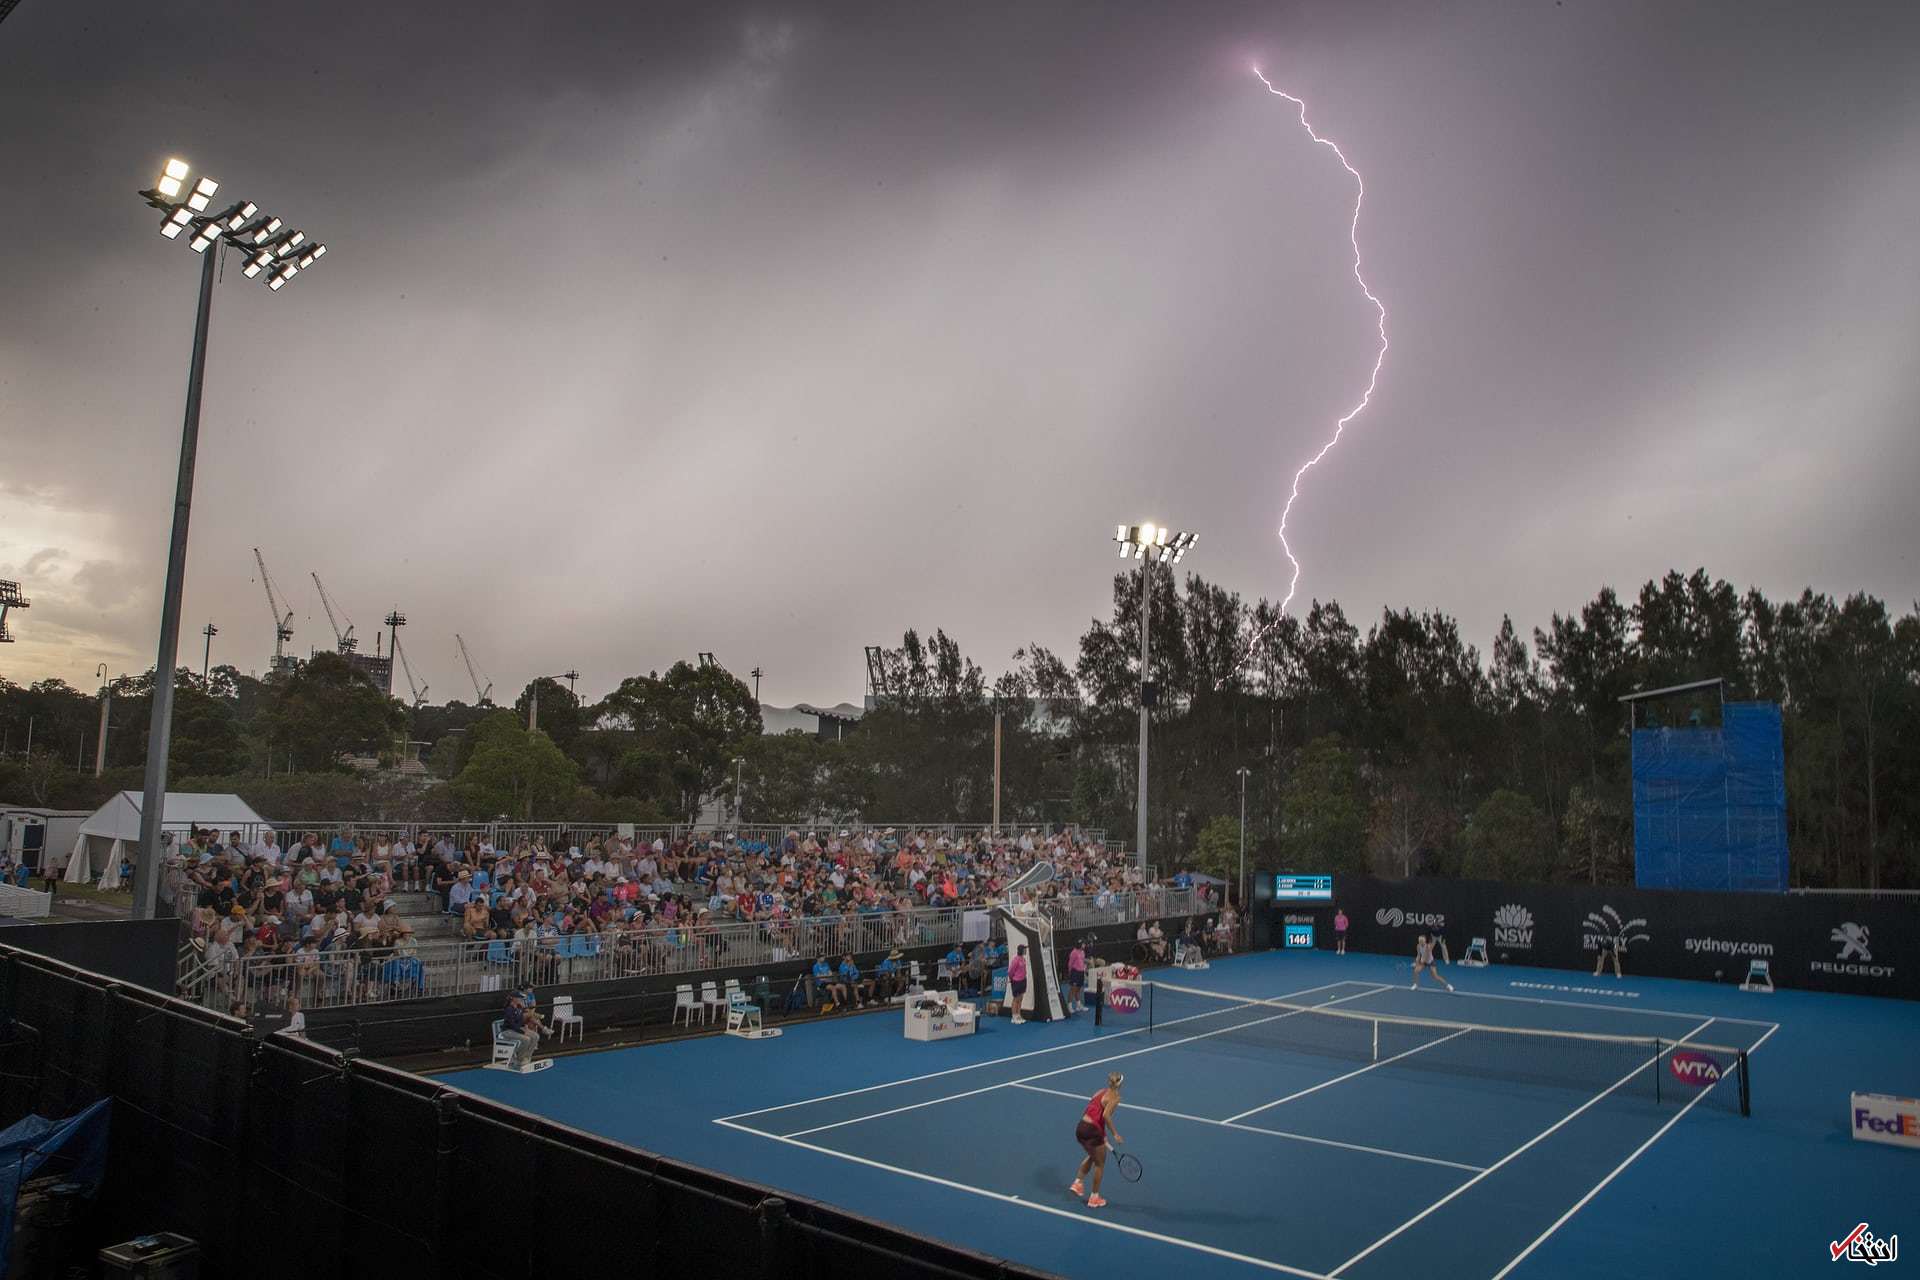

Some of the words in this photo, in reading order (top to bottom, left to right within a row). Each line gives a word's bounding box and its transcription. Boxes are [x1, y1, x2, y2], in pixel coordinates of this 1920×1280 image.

[1494, 927, 1533, 943] NSW
[1685, 937, 1774, 956] sydney.com
[1810, 961, 1895, 978] PEUGEOT
[1111, 993, 1140, 1008] WTA
[1672, 1059, 1720, 1079] WTA
[1855, 1108, 1920, 1137] FedE
